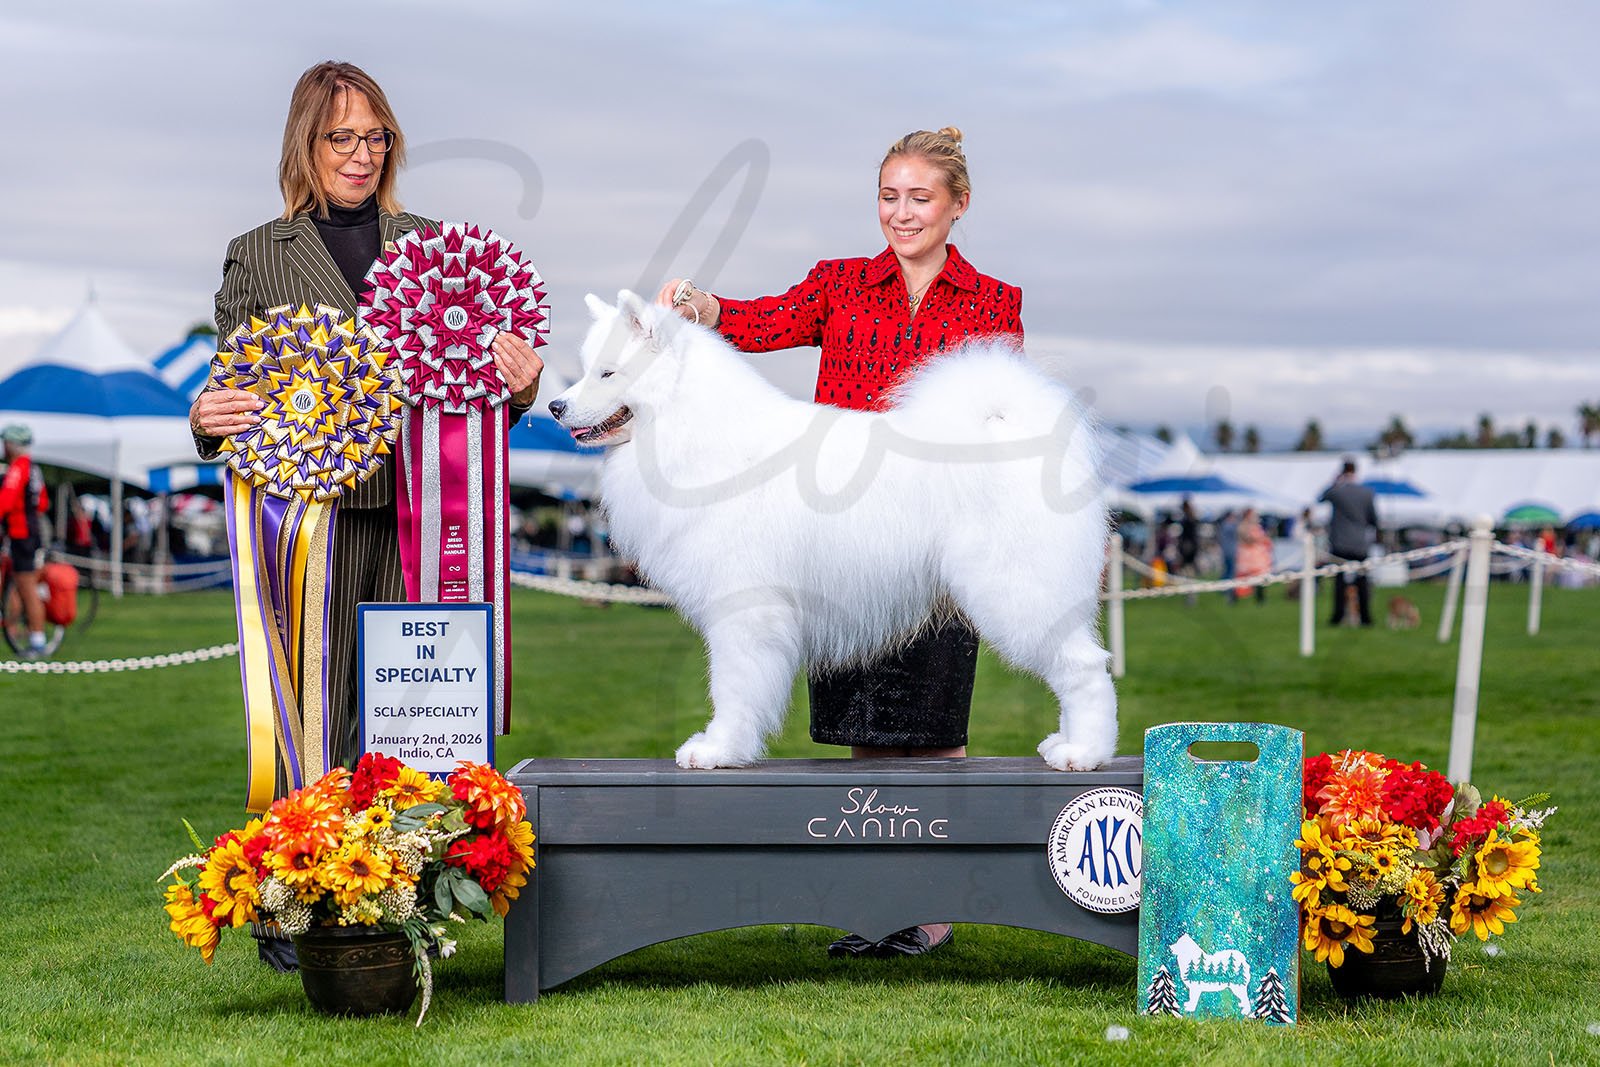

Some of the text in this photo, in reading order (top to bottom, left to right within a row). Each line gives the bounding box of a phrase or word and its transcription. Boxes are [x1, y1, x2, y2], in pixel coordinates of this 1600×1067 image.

[402, 622, 449, 637] BEST
[416, 645, 435, 660] IN
[375, 667, 477, 683] SPECIALTY
[374, 706, 479, 718] SCLA SPECIALTY
[370, 733, 482, 747] January 2nd, 2026
[399, 747, 454, 760] Indio, CA
[841, 787, 919, 817] Show
[1056, 799, 1096, 863] AMERICAN
[1076, 886, 1126, 906] FOUNDED
